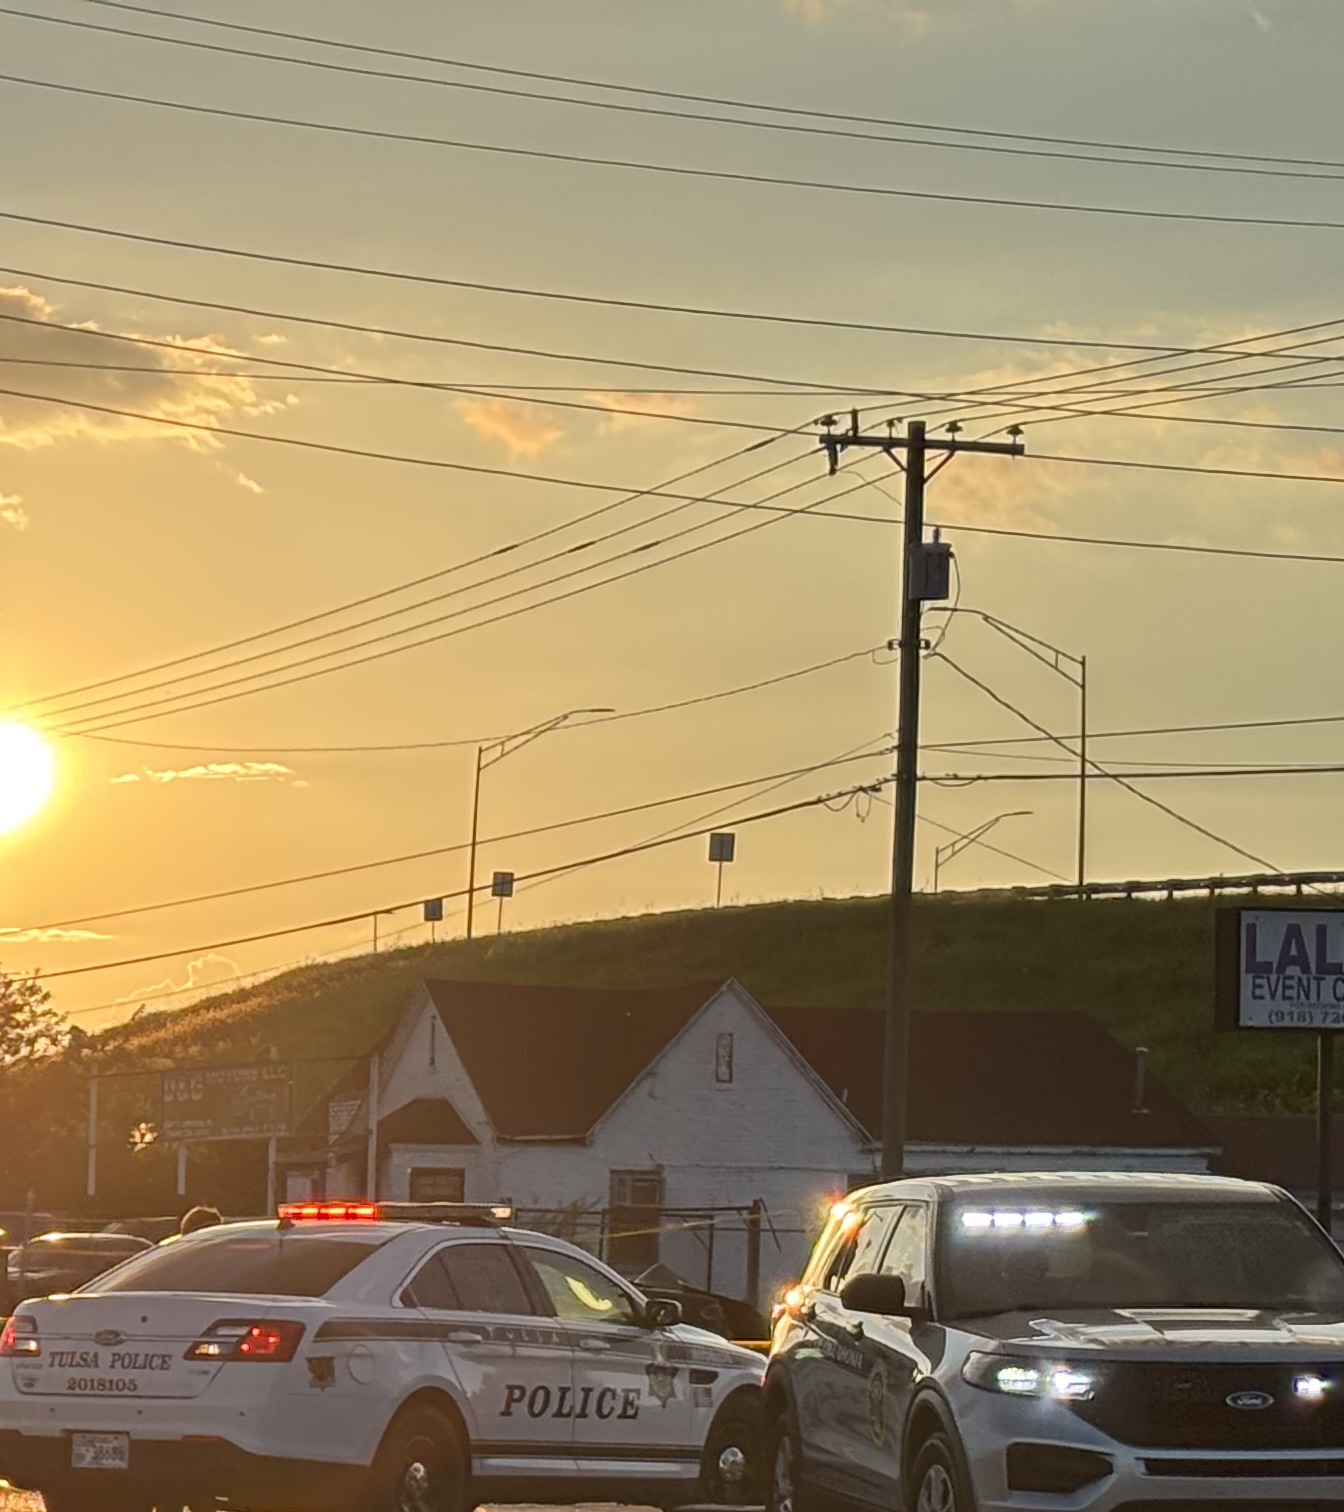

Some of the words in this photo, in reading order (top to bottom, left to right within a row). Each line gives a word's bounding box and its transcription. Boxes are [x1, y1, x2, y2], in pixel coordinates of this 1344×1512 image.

[1245, 922, 1344, 976] LAL
[1251, 975, 1327, 1001] EVENT
[1268, 1010, 1313, 1025] (918)
[1320, 1010, 1344, 1024] 72
[47, 1351, 100, 1369] TULSA
[109, 1352, 172, 1371] POLICE
[66, 1376, 139, 1392] 2018105
[499, 1384, 642, 1420] POLICE
